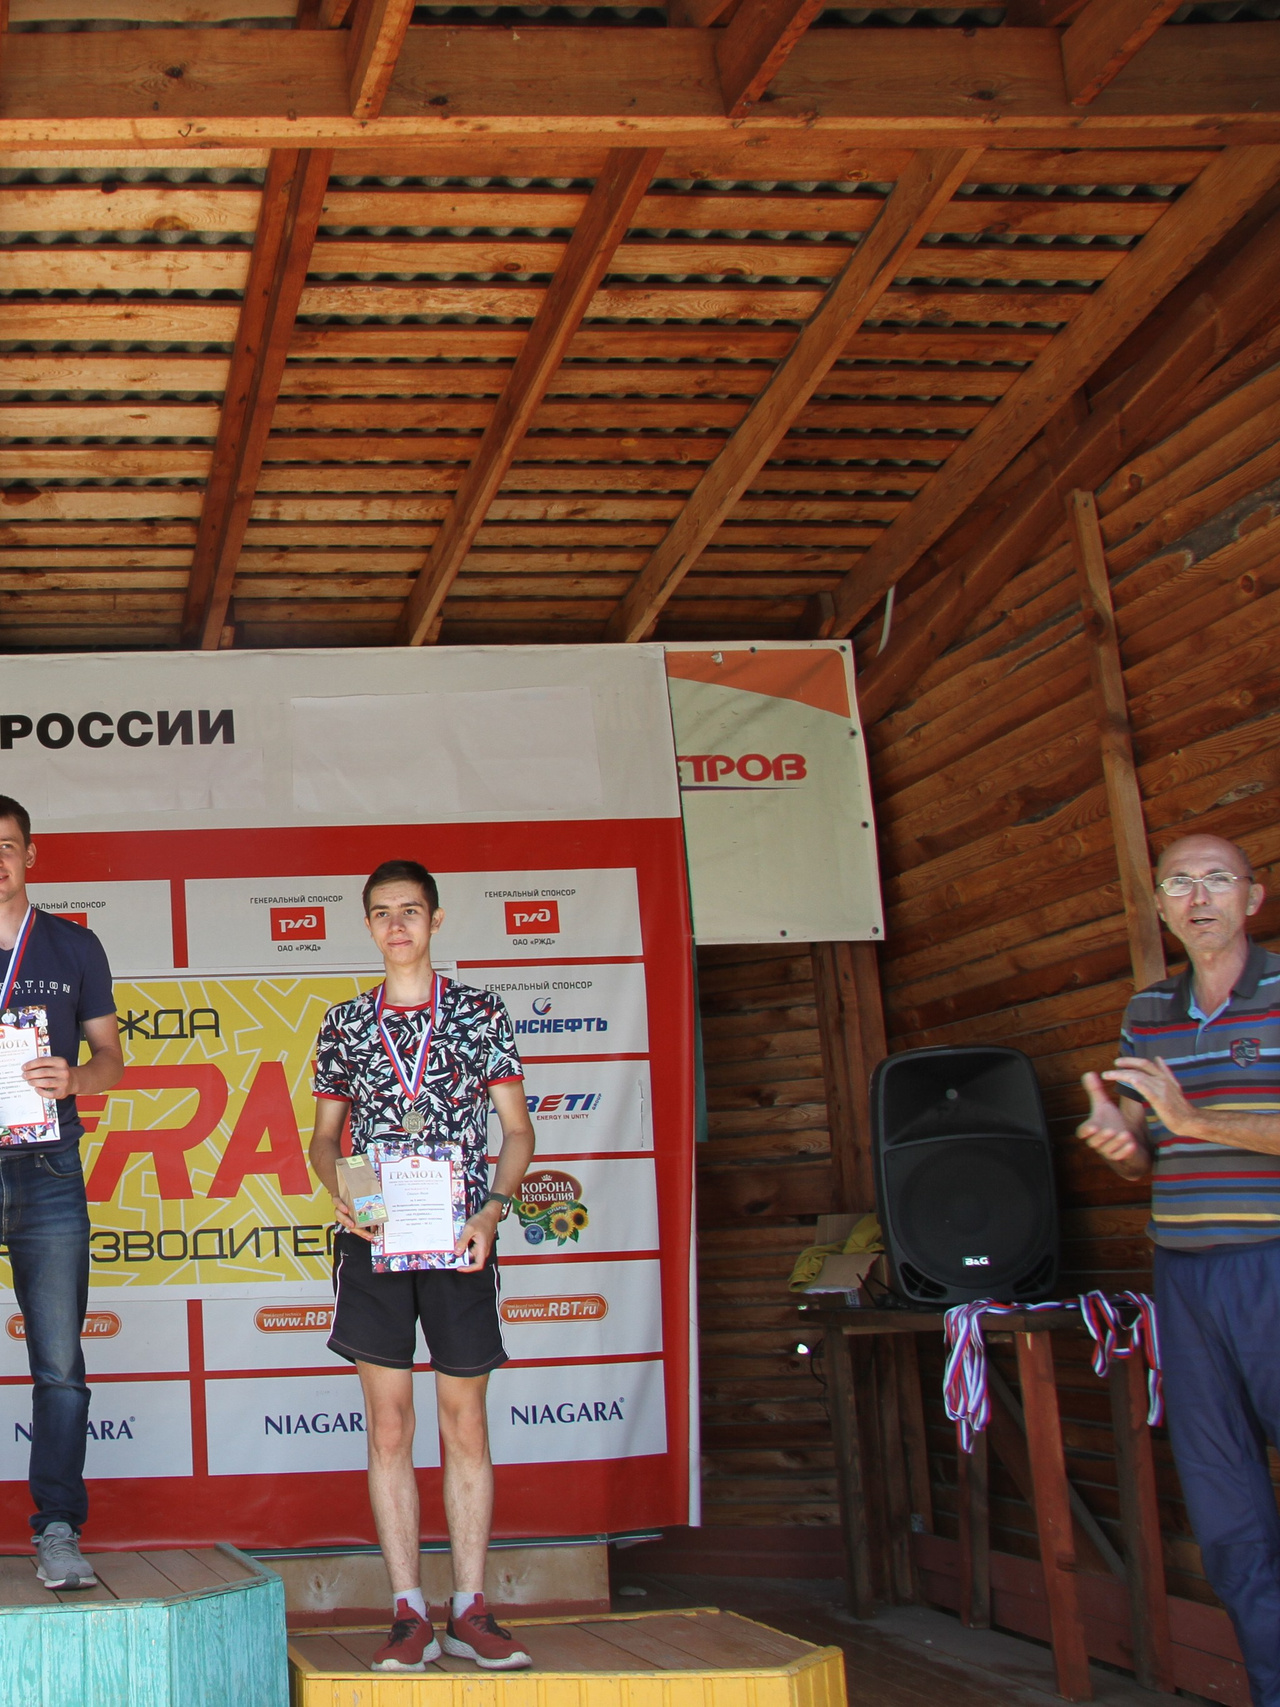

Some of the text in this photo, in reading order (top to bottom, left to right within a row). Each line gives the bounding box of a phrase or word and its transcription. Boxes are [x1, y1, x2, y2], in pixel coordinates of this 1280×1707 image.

[0, 708, 236, 750] РОССИИ
[677, 753, 807, 782] ТРОВ
[249, 895, 343, 904] ГЕНЕРАЛЬНЫЙ СПОНСОР
[484, 888, 576, 898] ГЕНЕРАЛЬНЫЙ СПОНСОР
[30, 901, 106, 910] РАЛЬНЫЙ СПОНСОР
[484, 981, 593, 992] ГЕНЕРАЛЬНЫЙ СПОНСОР
[117, 1008, 220, 1041] ЖДА
[514, 1017, 608, 1034] НСНЕФТЬ
[389, 1170, 443, 1180] ГРАМОТА
[521, 1181, 574, 1194] КОРОНА
[521, 1191, 575, 1203] ИЗОБИЛИЯ
[90, 1225, 334, 1263] ЗВОДИТЕ
[507, 1301, 598, 1318] www.RBT.ru
[265, 1412, 368, 1435] NIAGAR
